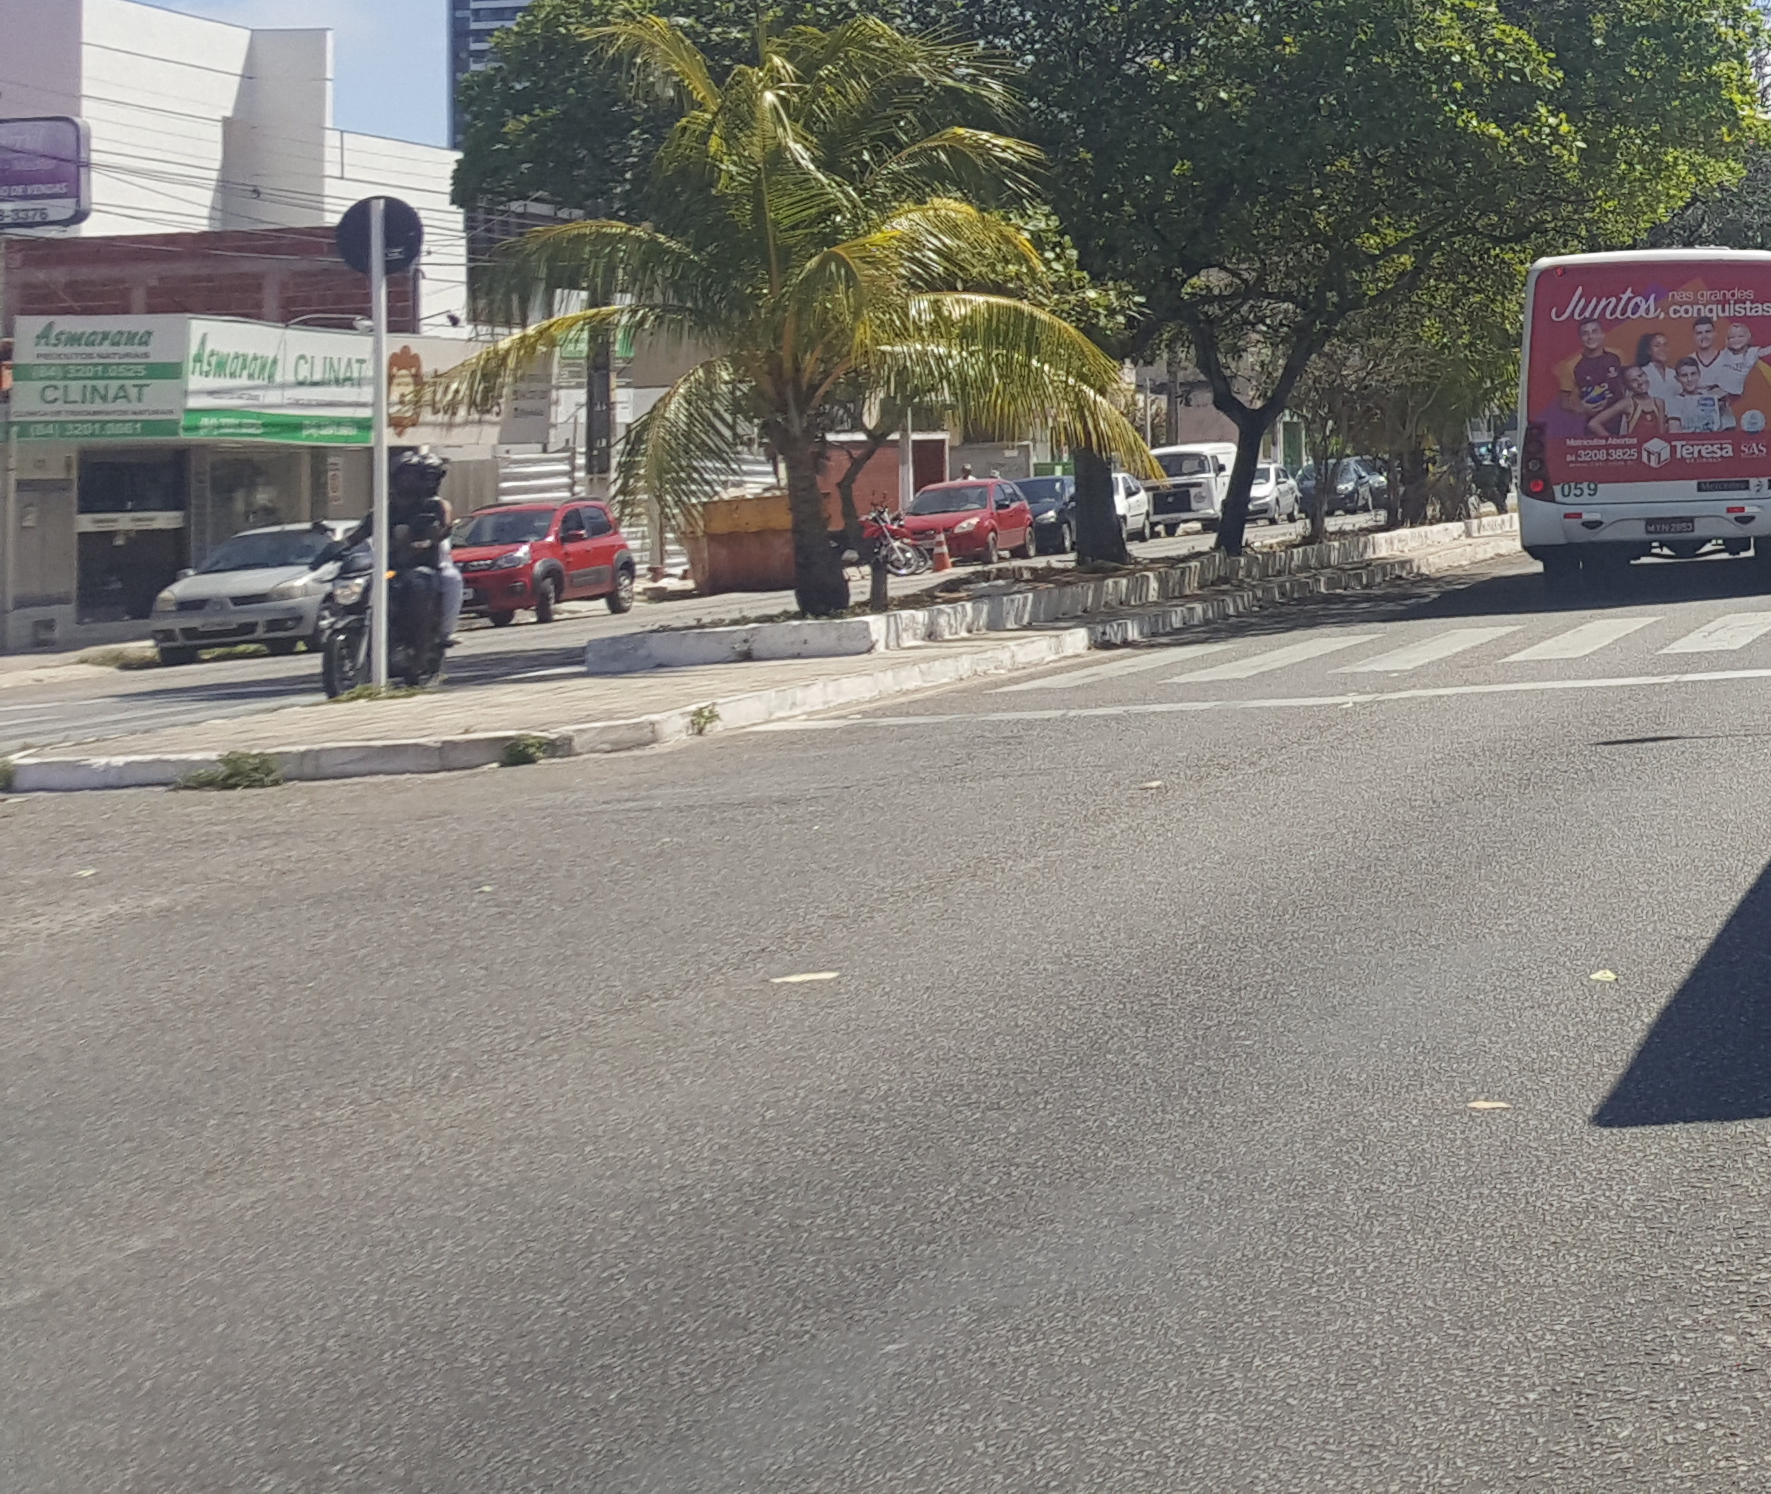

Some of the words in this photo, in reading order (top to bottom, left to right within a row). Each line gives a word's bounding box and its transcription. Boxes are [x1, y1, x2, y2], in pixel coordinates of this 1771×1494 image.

[1551, 285, 1665, 322] Juntos,
[1668, 291, 1694, 302] nas
[1697, 287, 1754, 304] grandes
[293, 354, 367, 387] CLINAT
[40, 383, 152, 404] CLINAT
[1608, 448, 1638, 460] 3825
[1671, 439, 1734, 459] Teresa
[1561, 480, 1598, 498] 059
